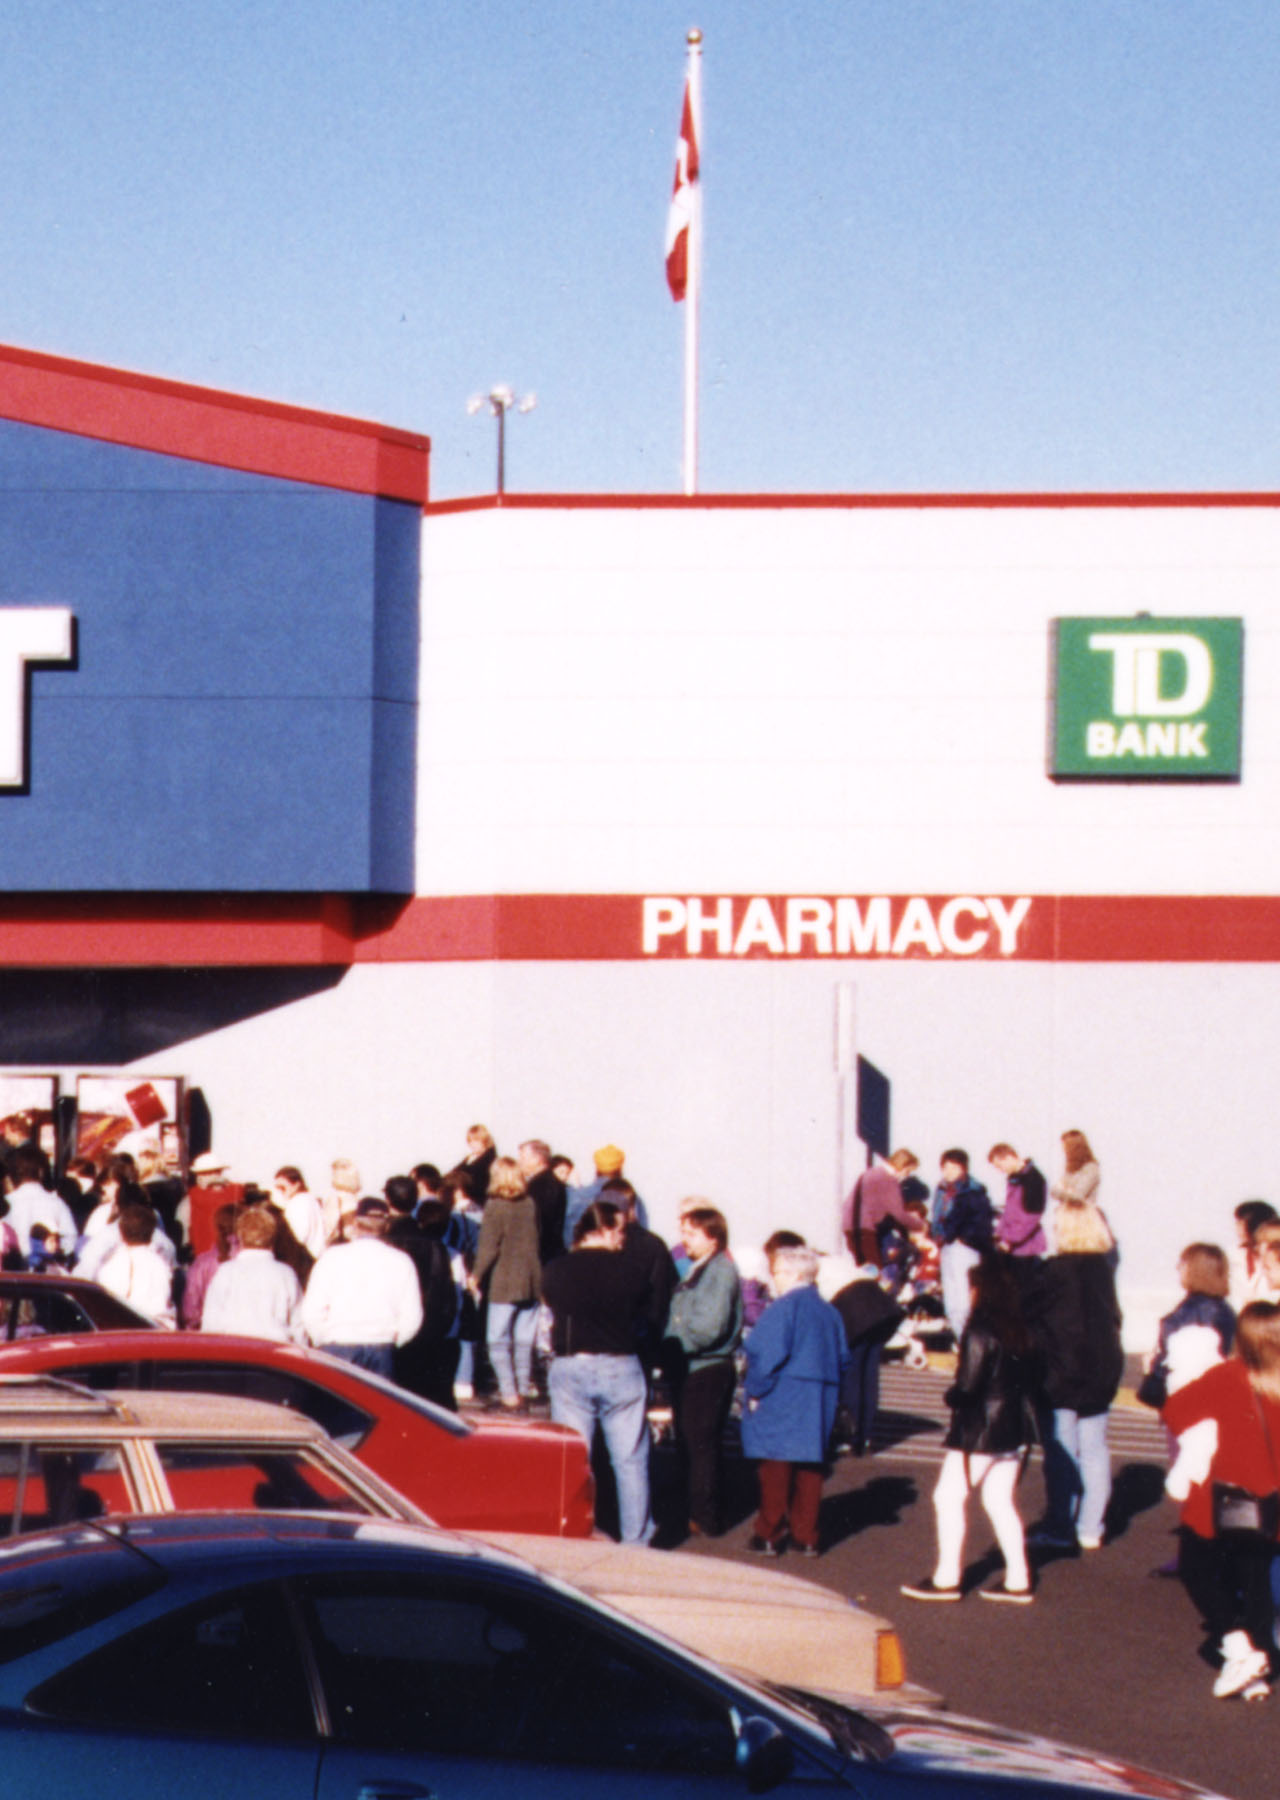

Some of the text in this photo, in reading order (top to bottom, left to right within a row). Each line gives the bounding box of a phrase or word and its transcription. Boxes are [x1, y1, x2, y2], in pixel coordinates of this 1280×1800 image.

[1086, 632, 1213, 717] TD
[1084, 722, 1210, 758] BANK
[641, 896, 1033, 954] PHARMACY
